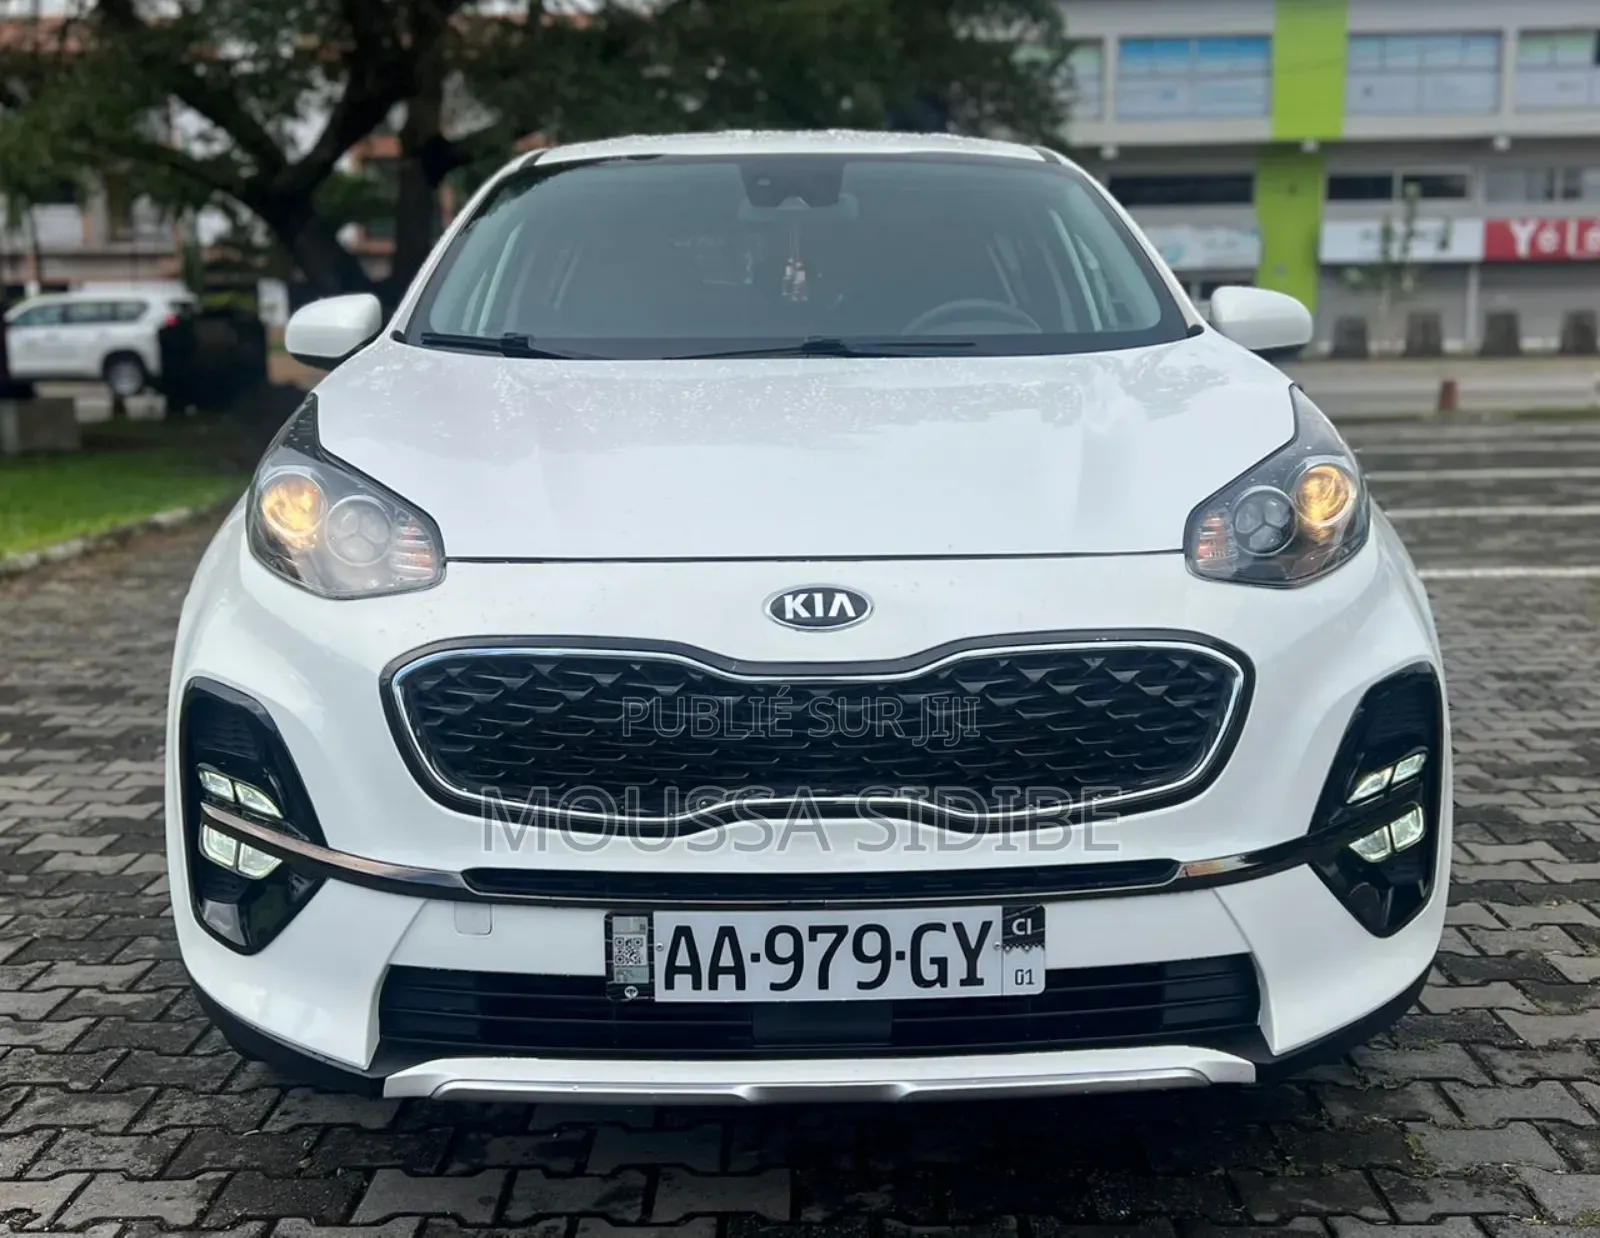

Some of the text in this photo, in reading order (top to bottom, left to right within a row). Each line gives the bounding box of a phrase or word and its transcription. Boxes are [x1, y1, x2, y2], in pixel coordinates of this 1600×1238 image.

[783, 592, 857, 620] KIA
[1011, 917, 1033, 936] CI
[1014, 967, 1036, 986] 01
